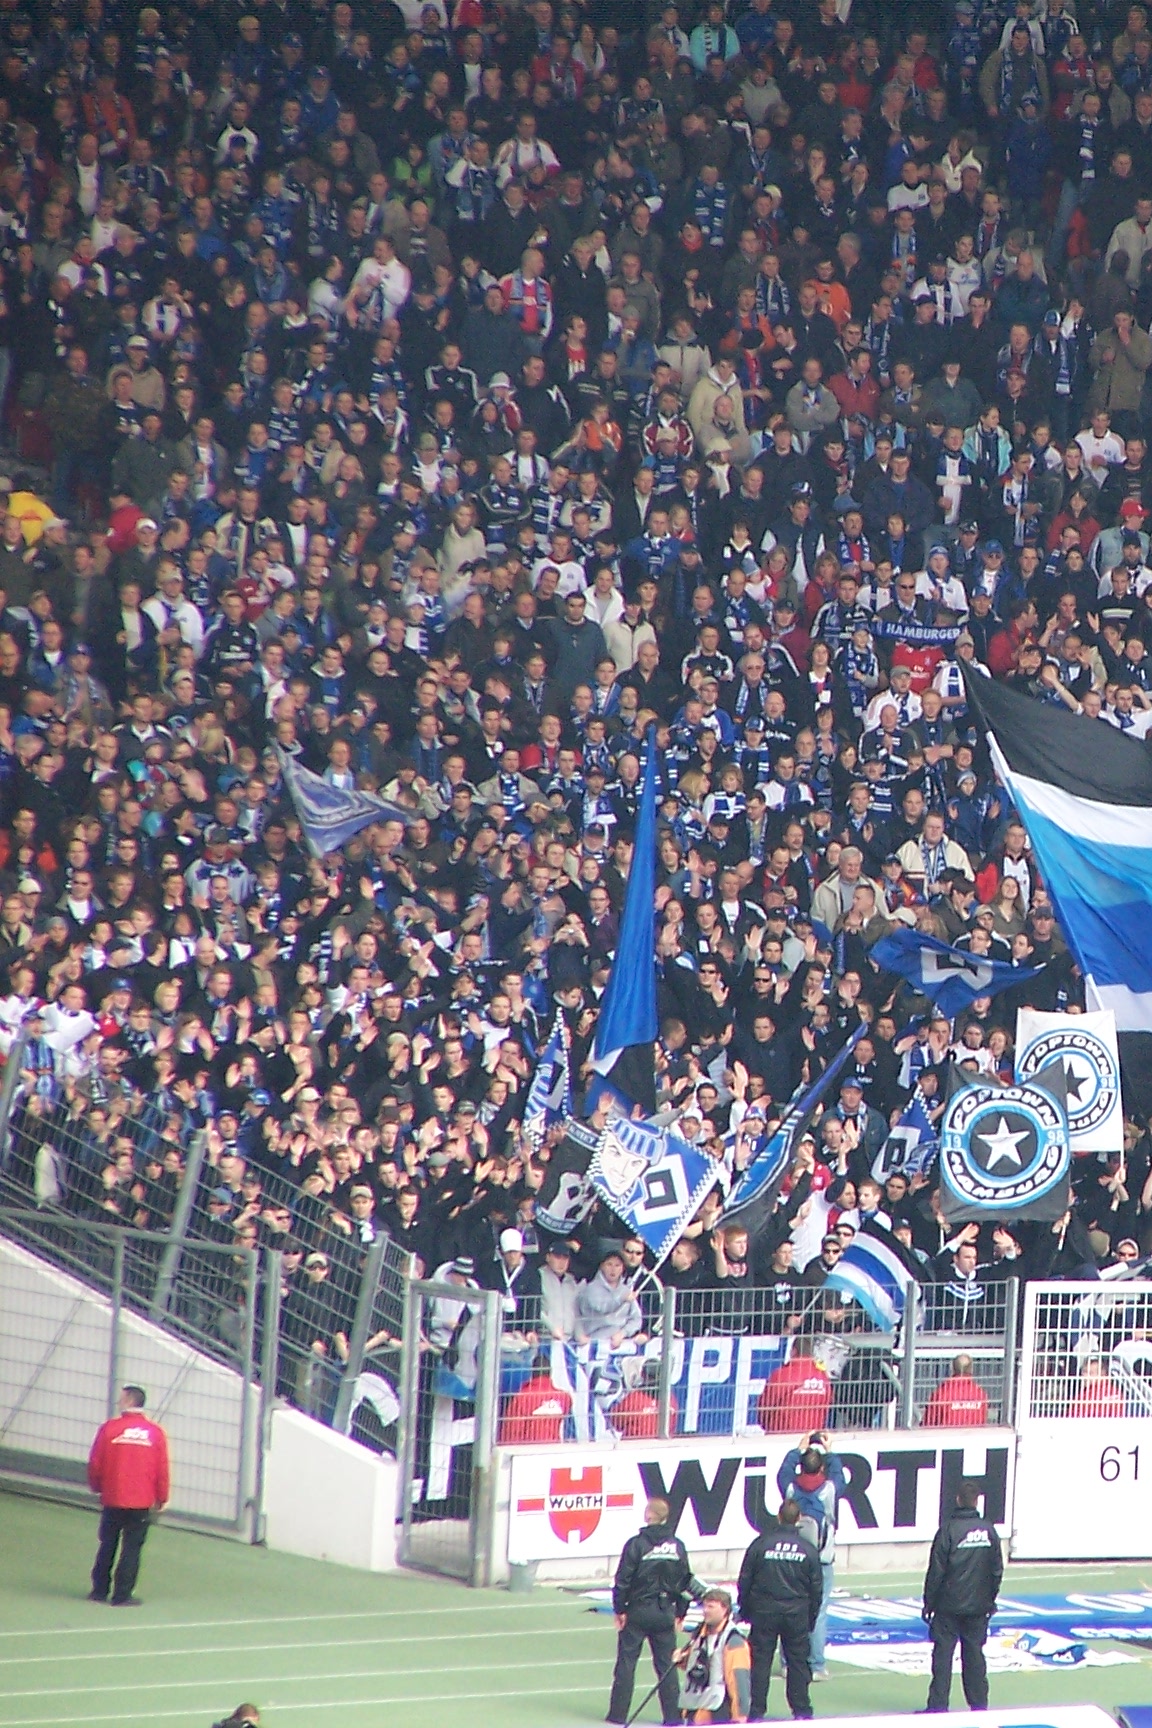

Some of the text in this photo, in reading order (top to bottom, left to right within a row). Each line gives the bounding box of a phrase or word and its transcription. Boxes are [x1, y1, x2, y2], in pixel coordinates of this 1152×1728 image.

[886, 622, 961, 640] HAMBURGER
[1025, 1035, 1112, 1073] POPTOWN
[950, 1086, 1059, 1132] POPTOWN
[950, 1145, 1061, 1199] HAMBURG
[1100, 1446, 1141, 1481] 61
